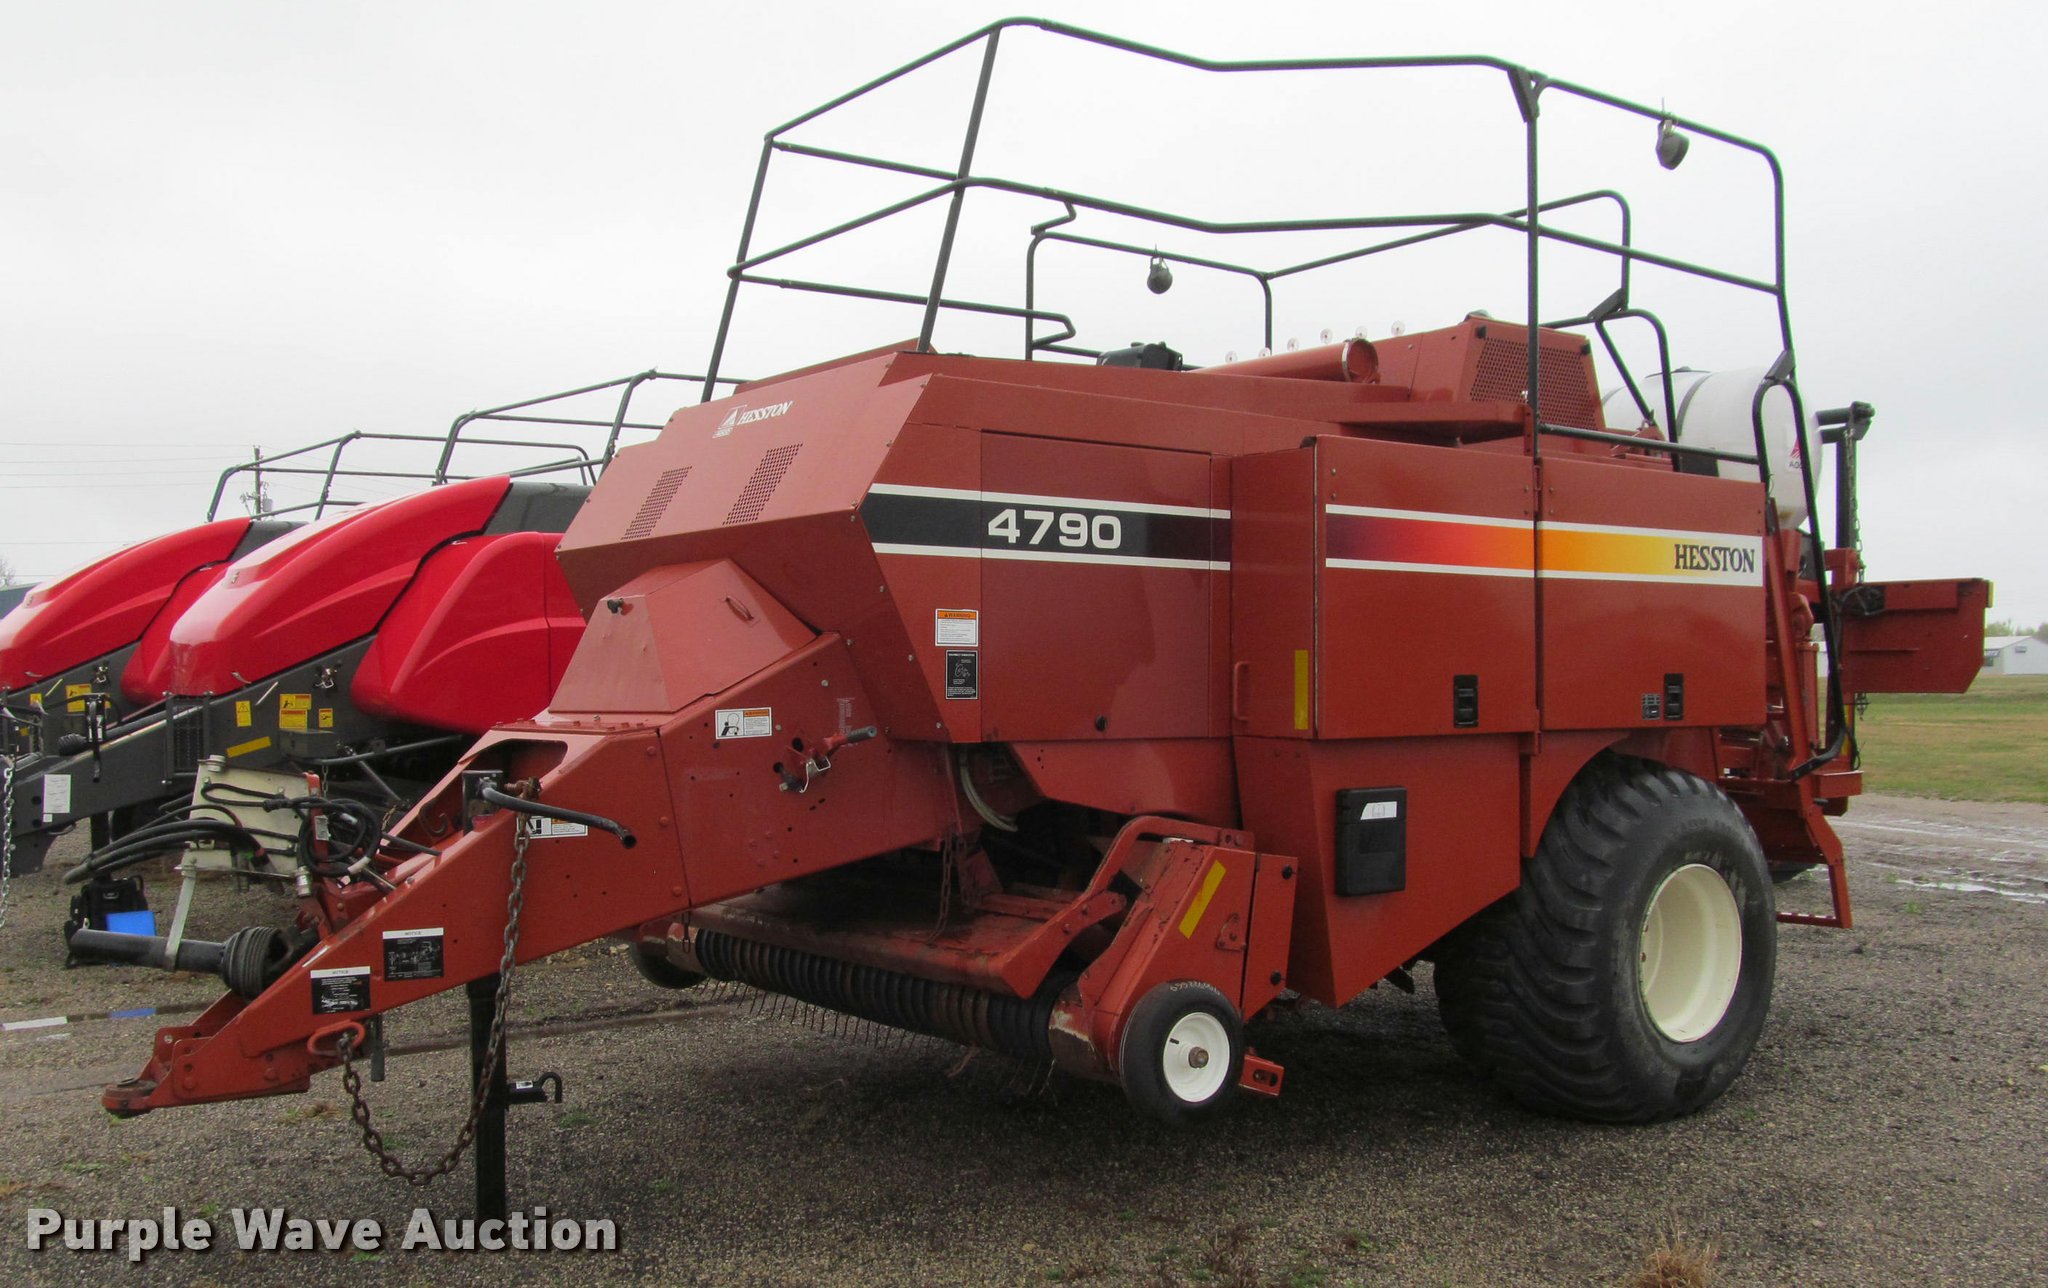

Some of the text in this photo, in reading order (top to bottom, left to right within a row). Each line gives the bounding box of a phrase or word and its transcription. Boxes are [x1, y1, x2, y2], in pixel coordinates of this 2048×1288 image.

[736, 400, 793, 426] HESSTON
[988, 508, 1122, 550] 4790
[1674, 543, 1755, 573] HESSTON
